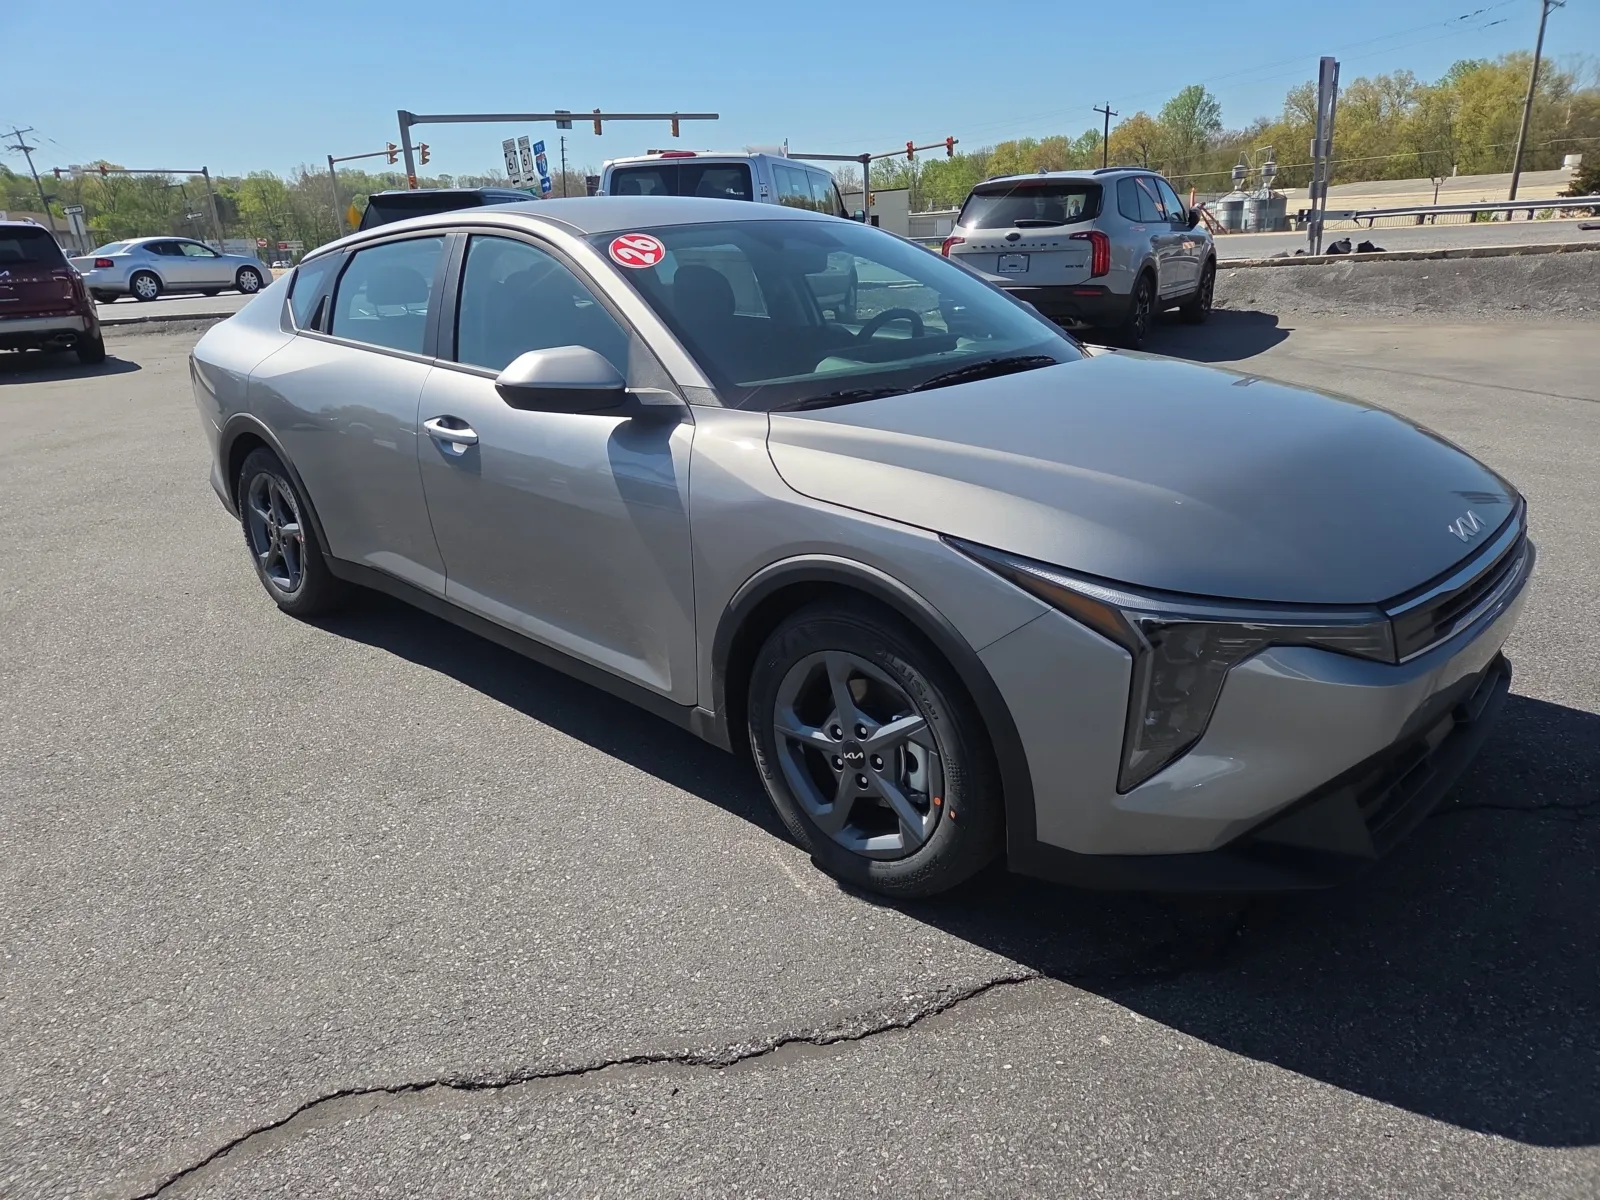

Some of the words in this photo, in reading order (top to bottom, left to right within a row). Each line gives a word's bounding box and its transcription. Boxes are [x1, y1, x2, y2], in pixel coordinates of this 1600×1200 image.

[535, 144, 543, 152] TO
[508, 156, 517, 170] 61
[523, 154, 531, 167] 61
[537, 159, 547, 173] 78
[616, 237, 658, 264] 26
[843, 751, 864, 760] KIA
